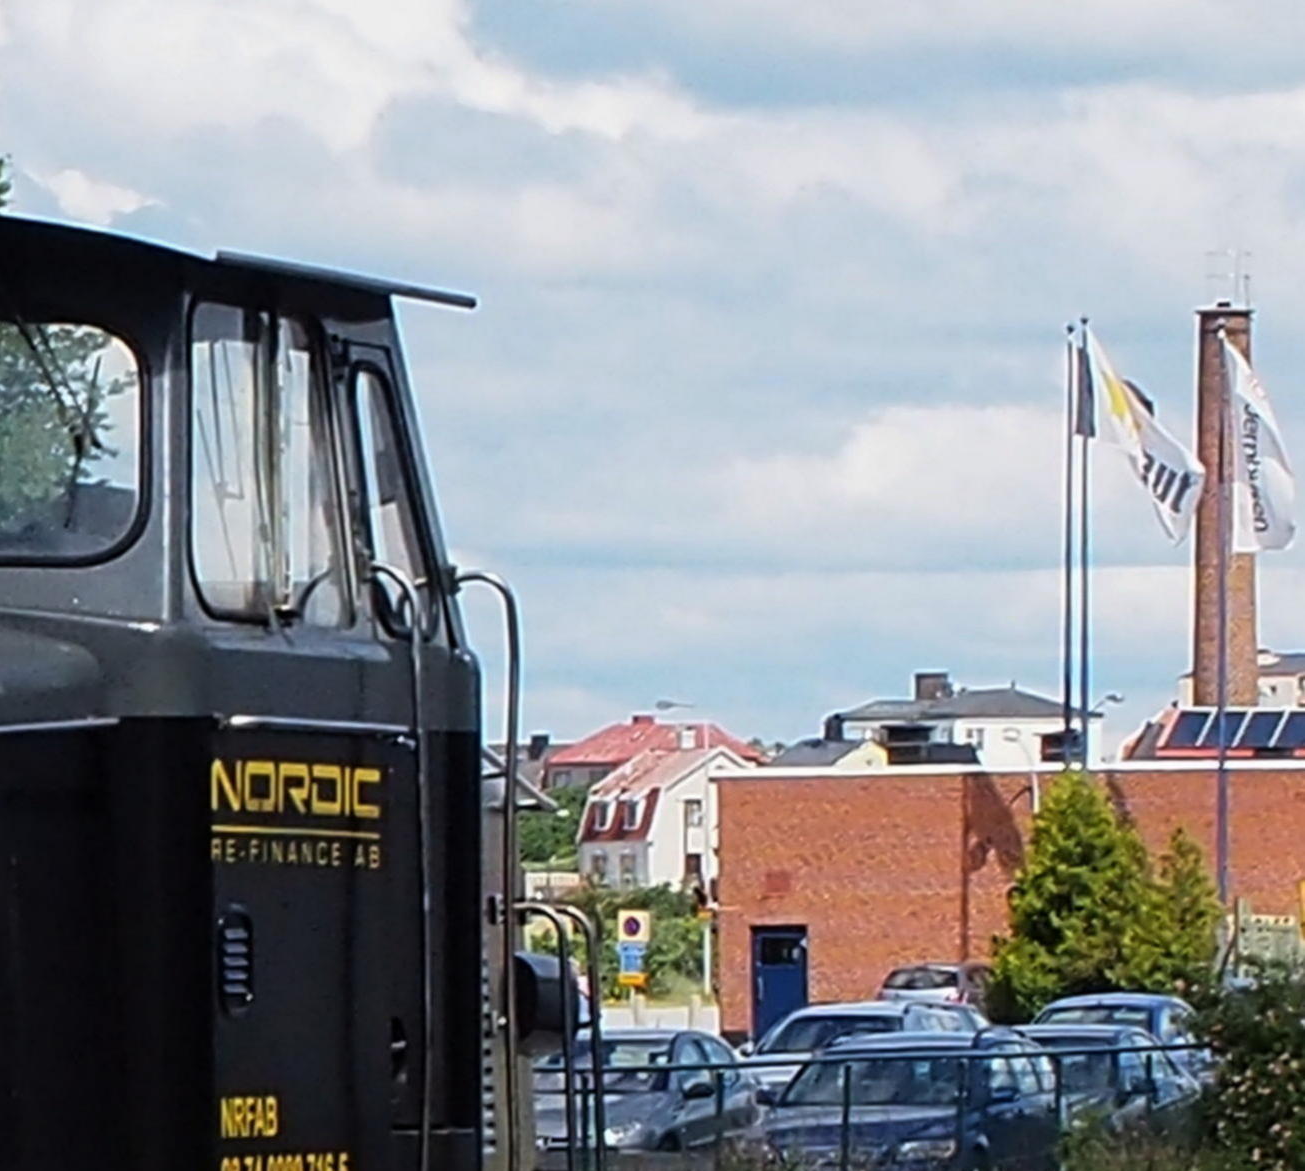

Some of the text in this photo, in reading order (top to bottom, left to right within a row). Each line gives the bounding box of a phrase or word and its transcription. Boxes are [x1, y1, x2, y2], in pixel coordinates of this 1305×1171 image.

[211, 758, 381, 818] NORDIC
[210, 838, 381, 869] RE-FINANCE AB
[220, 1095, 278, 1138] NRFAB
